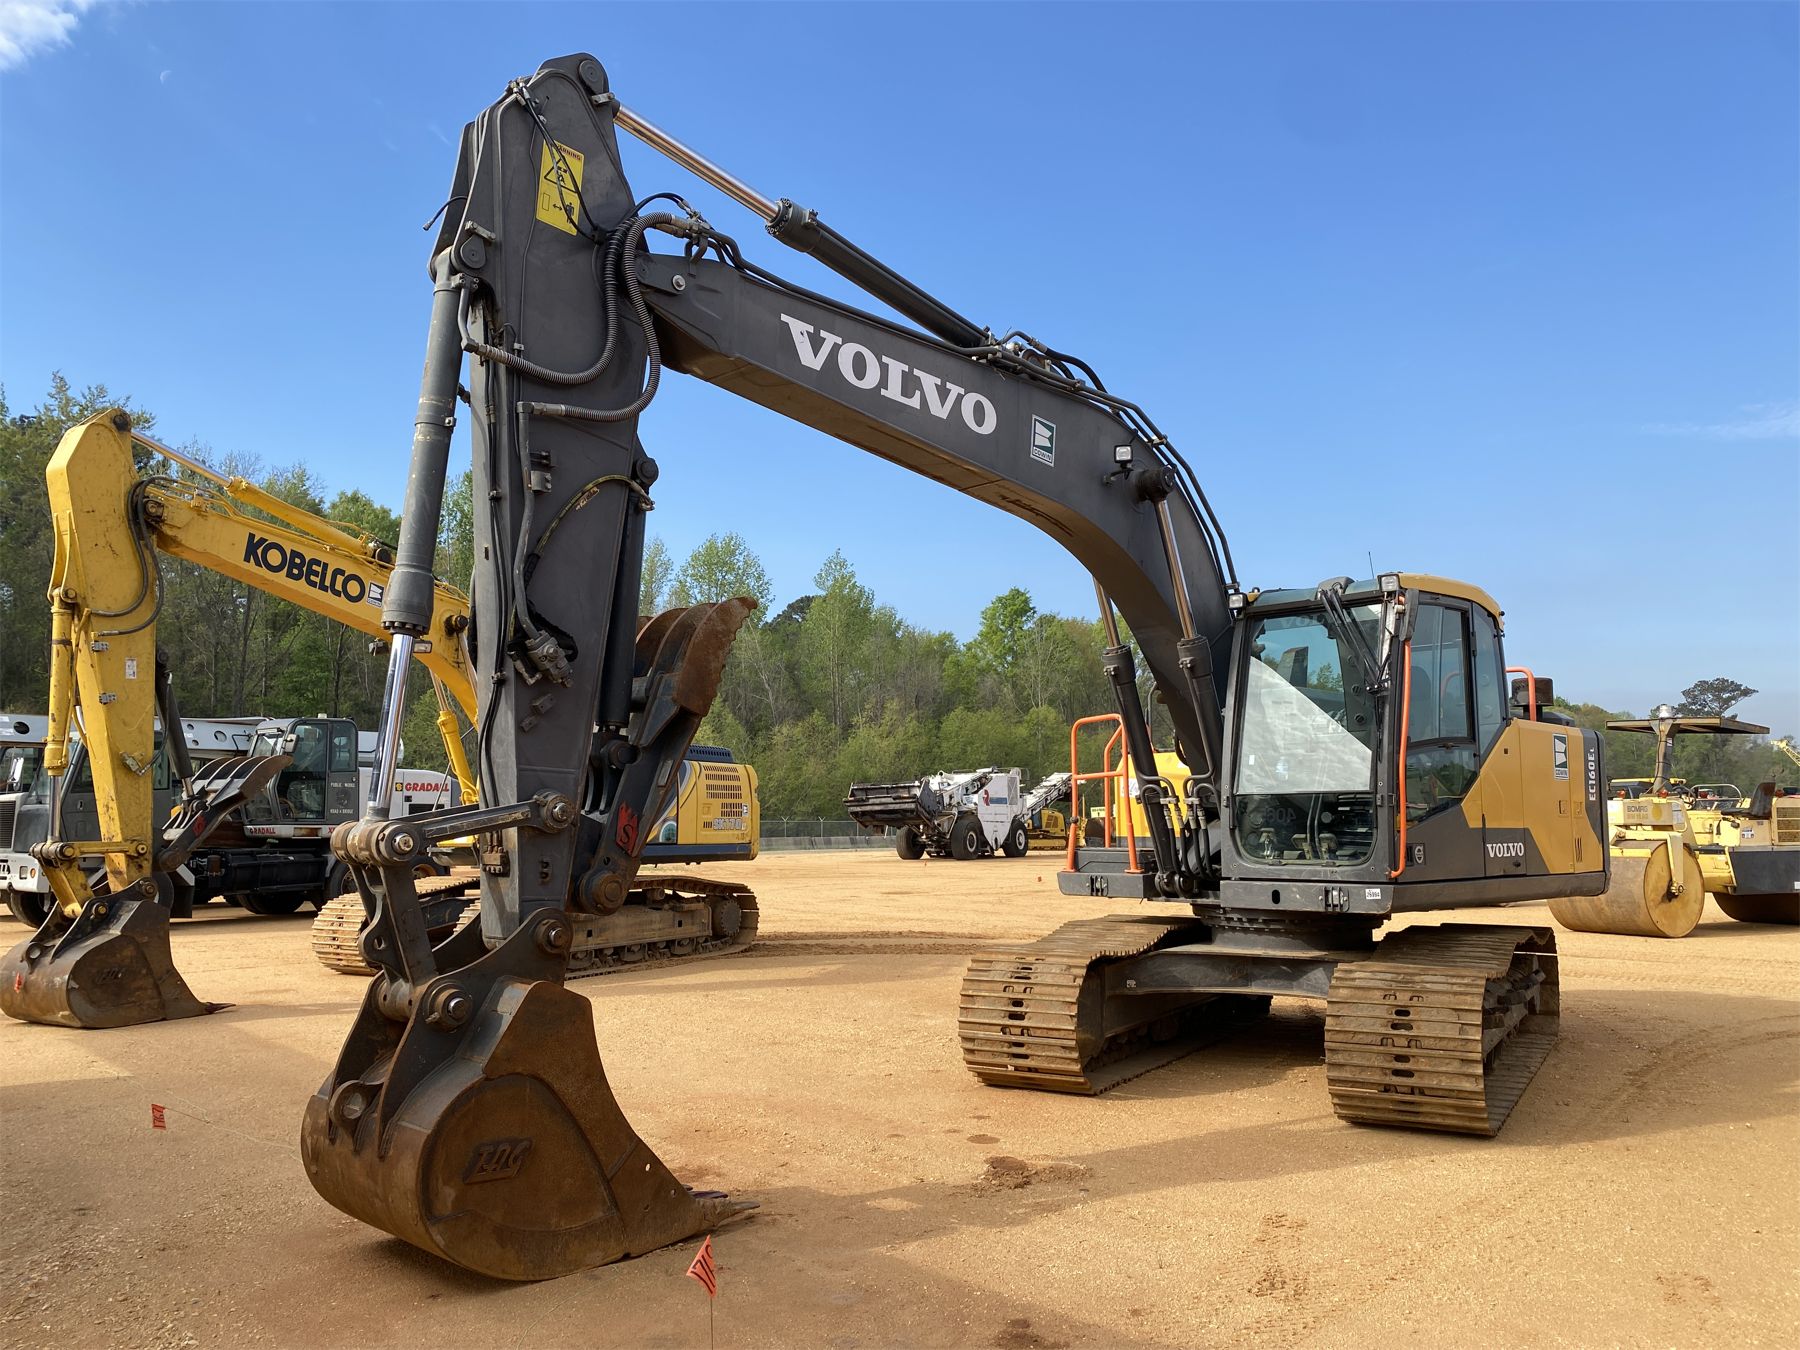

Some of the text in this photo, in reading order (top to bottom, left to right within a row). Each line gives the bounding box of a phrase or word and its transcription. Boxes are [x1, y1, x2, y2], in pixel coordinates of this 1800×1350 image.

[780, 313, 997, 435] VOLVO
[243, 531, 366, 603] KOBELCO
[1486, 842, 1525, 858] VOLVO
